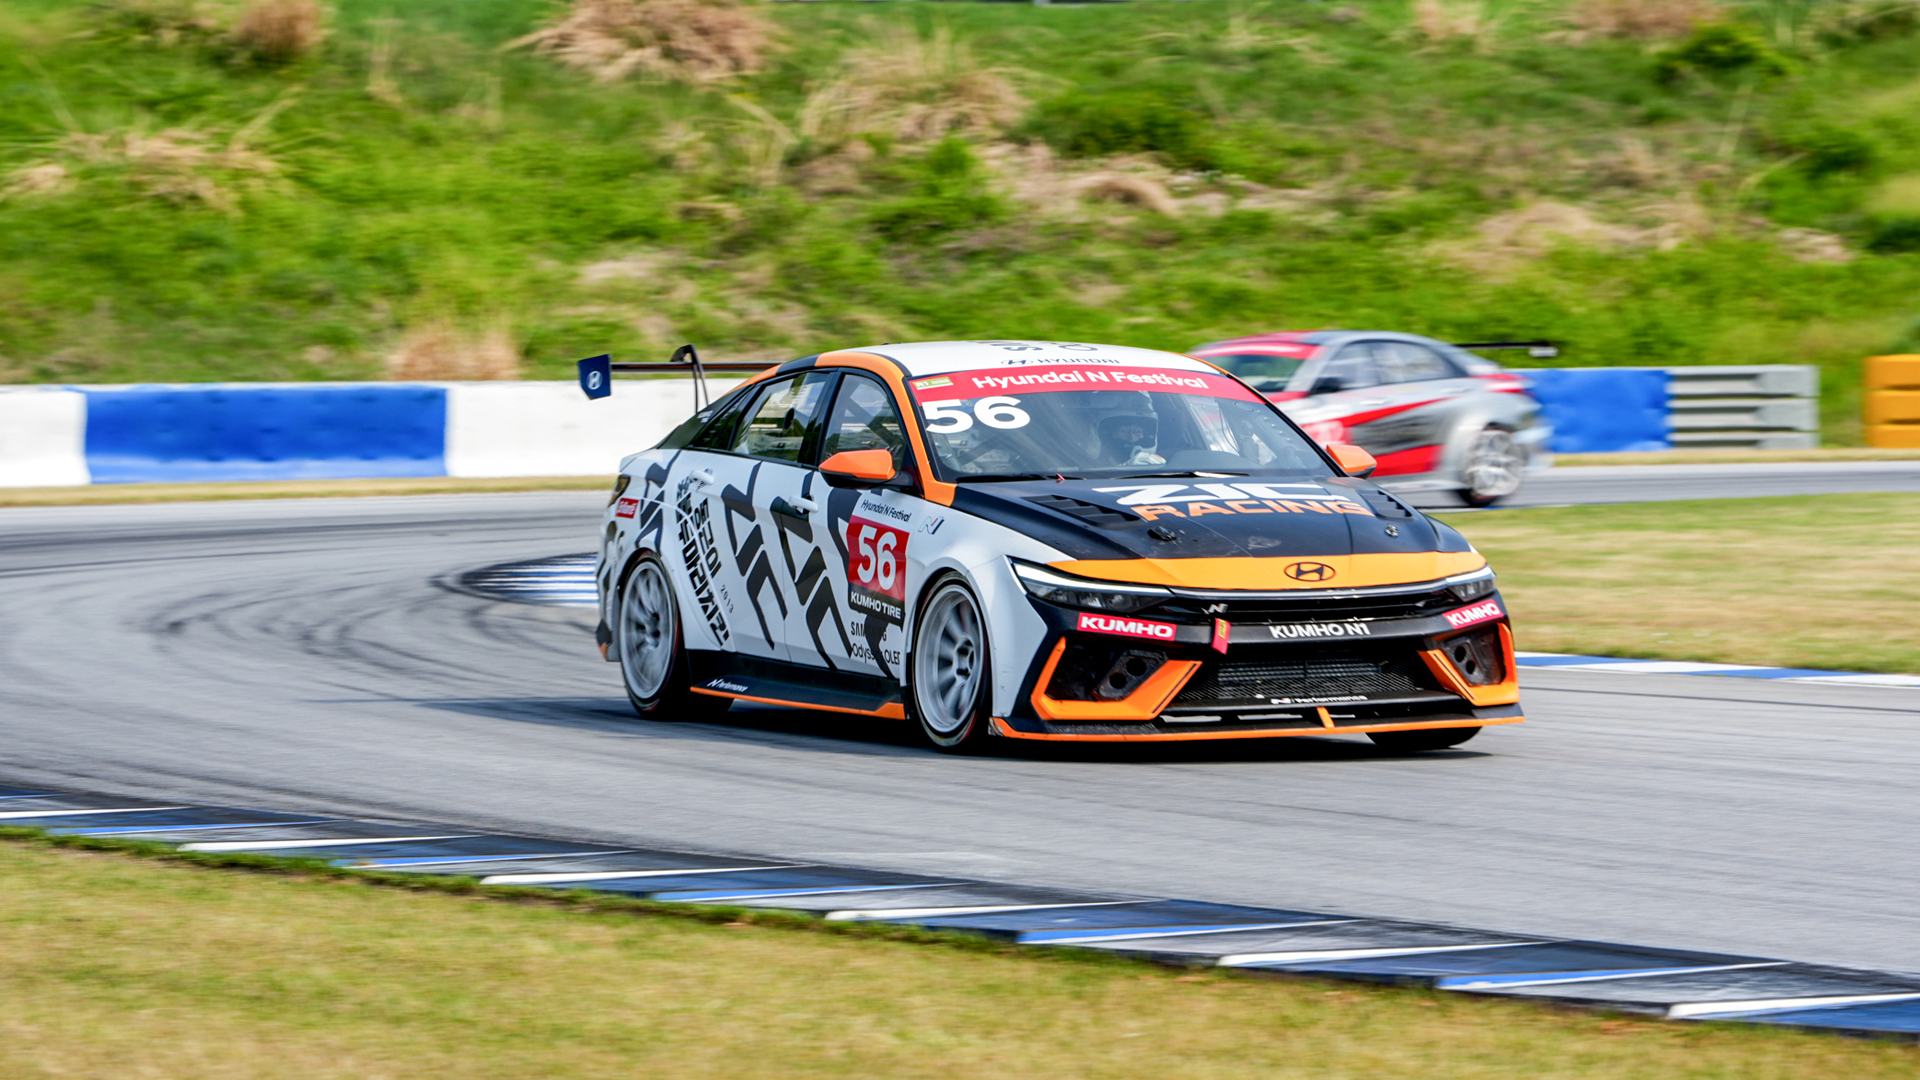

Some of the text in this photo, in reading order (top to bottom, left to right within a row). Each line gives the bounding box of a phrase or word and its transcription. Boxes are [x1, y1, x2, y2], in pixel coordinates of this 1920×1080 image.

[972, 370, 1209, 389] Hyundai N Festival
[921, 395, 1031, 434] 56
[1091, 483, 1351, 506] ZIC
[860, 499, 885, 514] Hyundai
[889, 507, 912, 523] Festival
[1131, 500, 1376, 521] RACING
[857, 524, 898, 591] 56
[850, 591, 902, 620] KUMHO TIRE
[1446, 602, 1500, 626] KUMHO
[850, 621, 887, 642] SAMG
[1081, 616, 1173, 638] KUMHO
[1269, 623, 1371, 639] KUMHO N1
